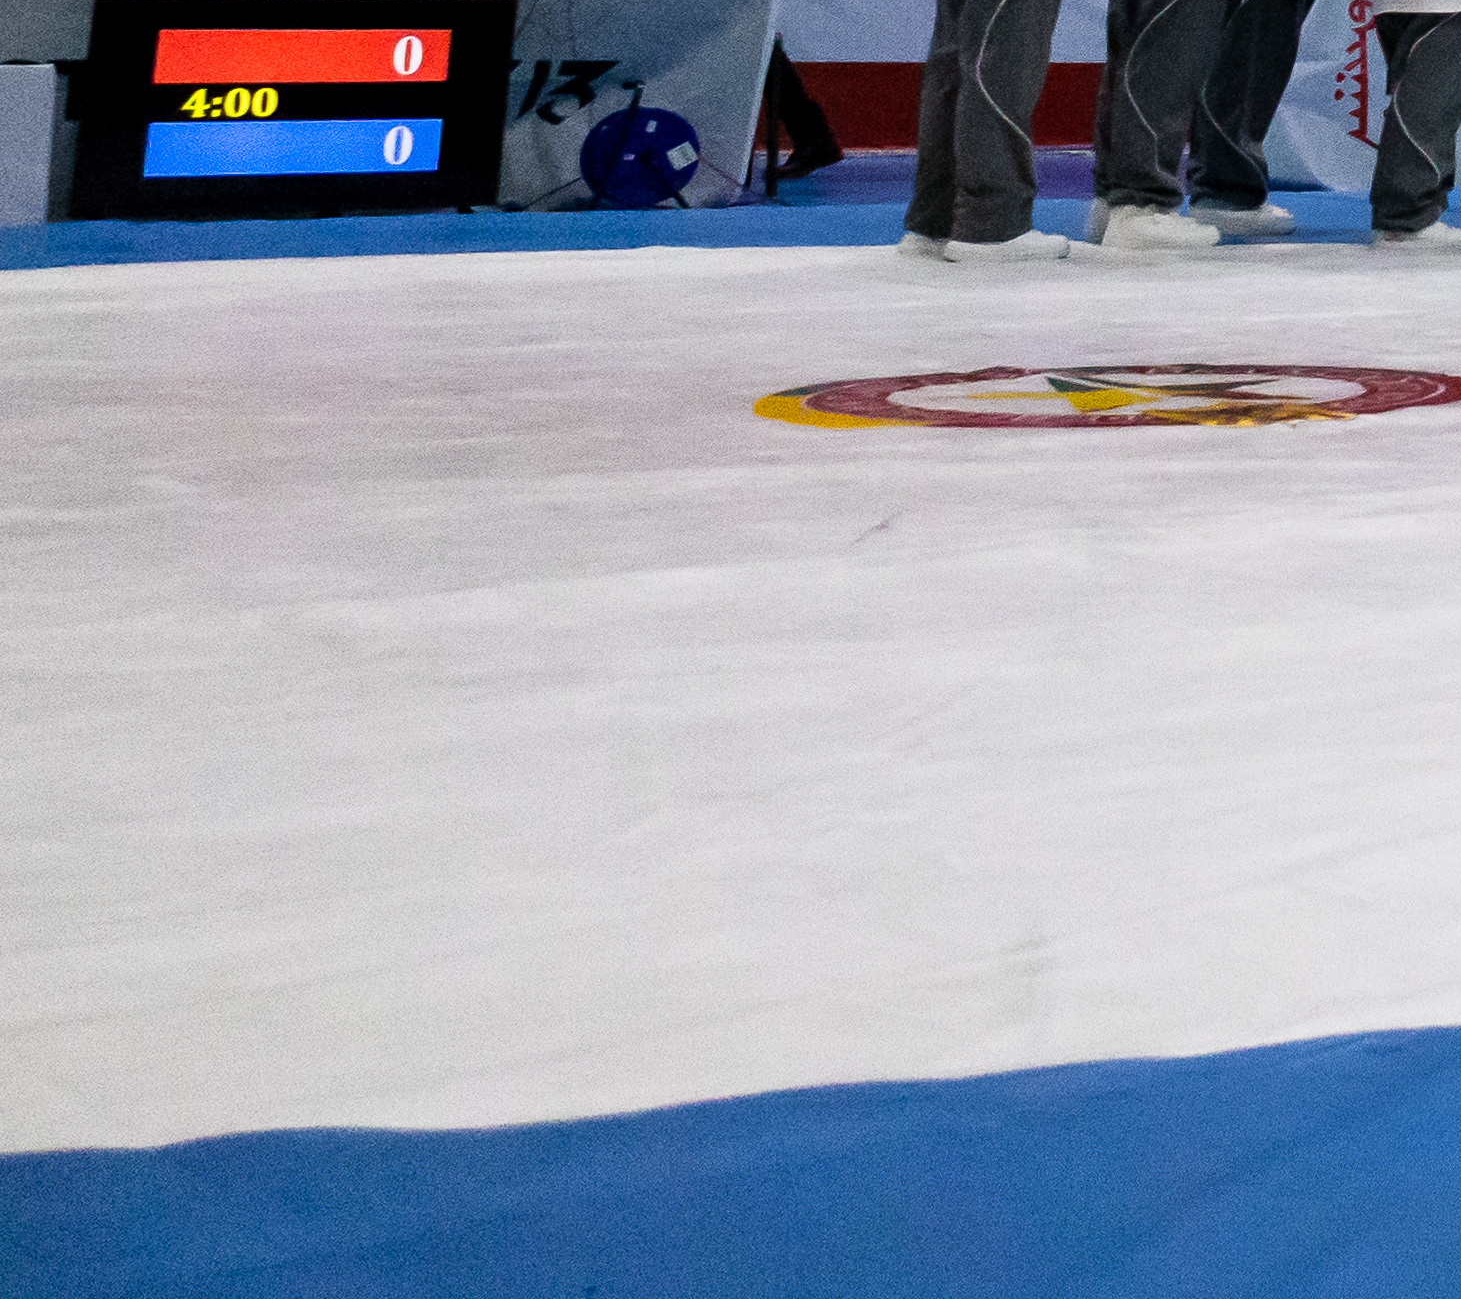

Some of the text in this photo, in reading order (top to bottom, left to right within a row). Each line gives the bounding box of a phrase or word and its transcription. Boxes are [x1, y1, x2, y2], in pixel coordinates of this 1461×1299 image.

[393, 35, 424, 76] 0
[181, 87, 280, 120] 4:00
[382, 125, 414, 167] 0
